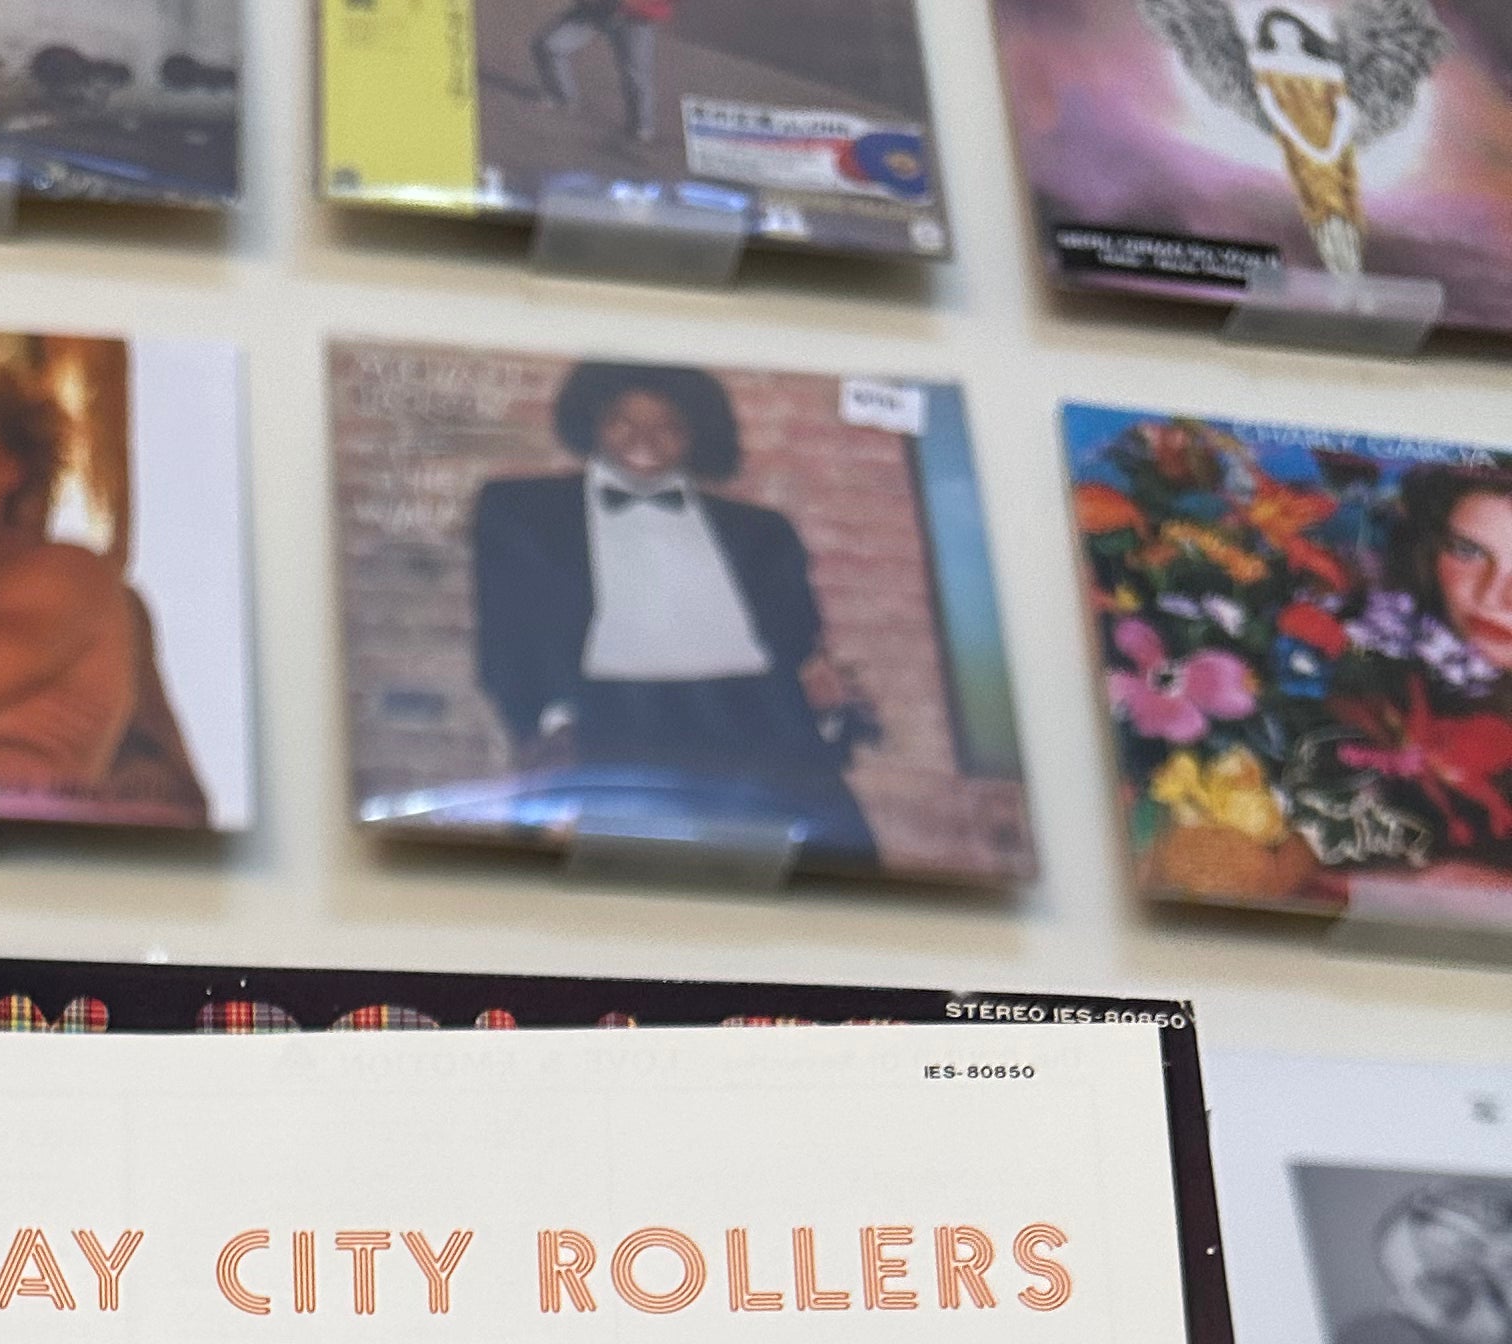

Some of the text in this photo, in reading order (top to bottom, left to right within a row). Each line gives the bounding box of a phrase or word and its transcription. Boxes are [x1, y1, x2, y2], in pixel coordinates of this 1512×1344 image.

[945, 1002, 1045, 1023] STEREO
[923, 1064, 1036, 1079] IES-80850
[215, 1227, 476, 1316] CITY
[536, 1222, 1074, 1315] ROLLERS
